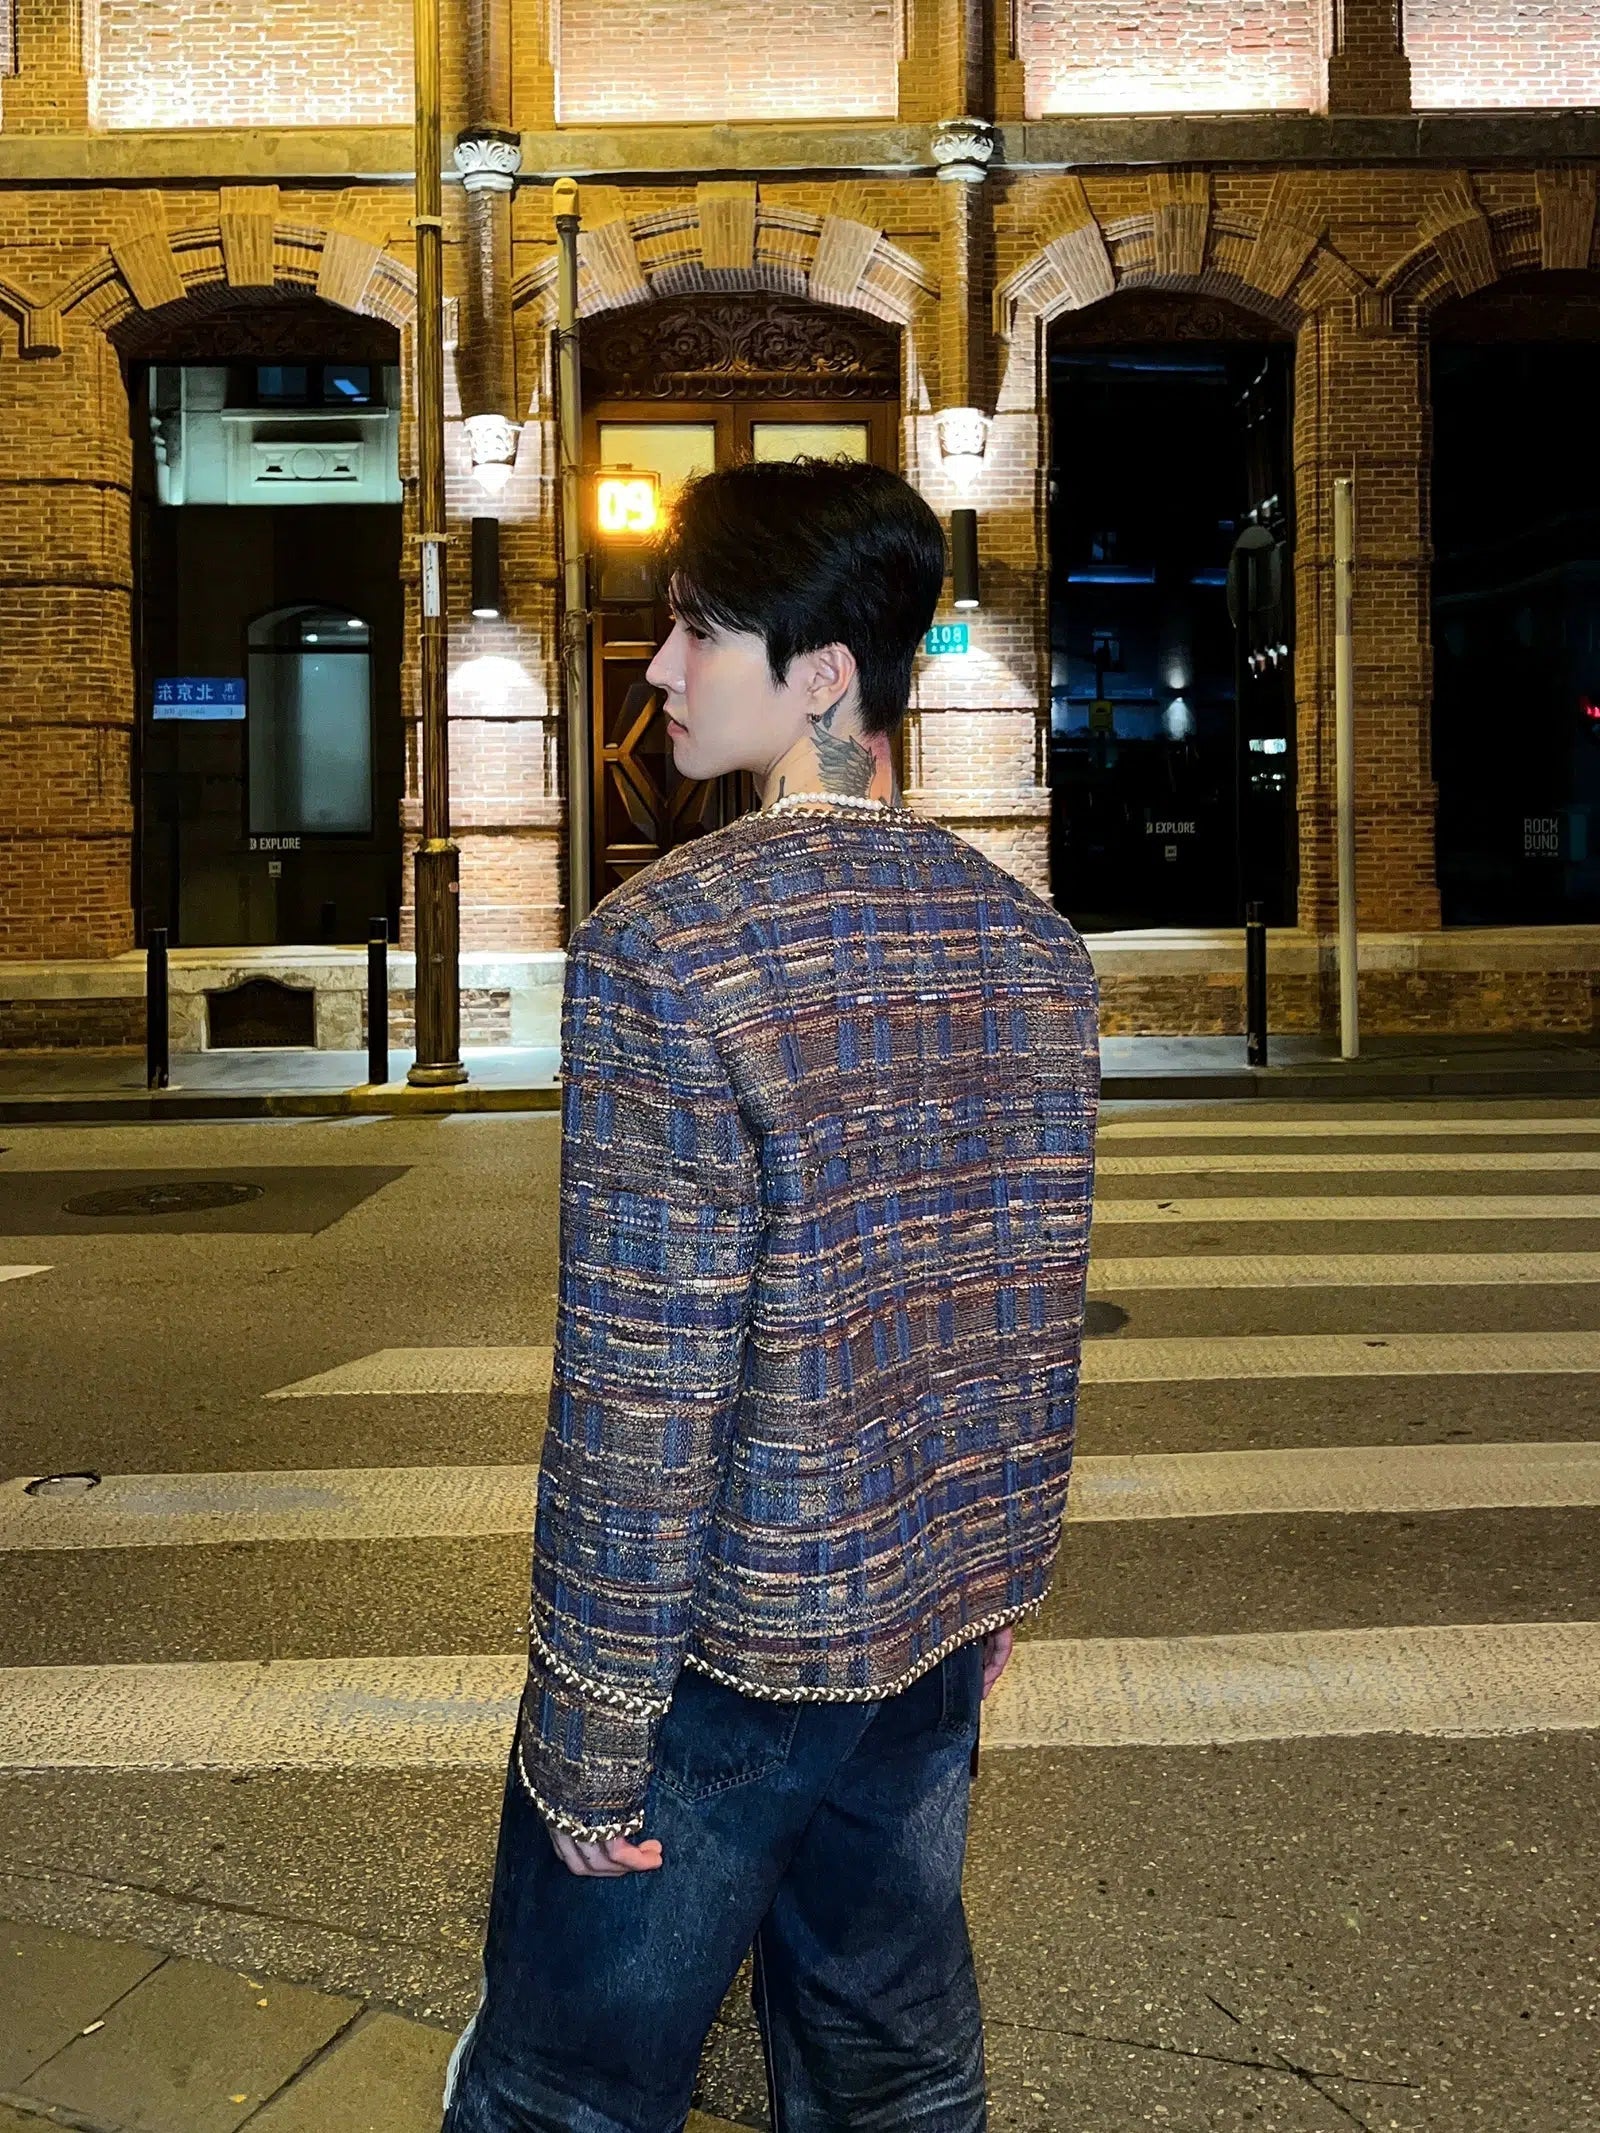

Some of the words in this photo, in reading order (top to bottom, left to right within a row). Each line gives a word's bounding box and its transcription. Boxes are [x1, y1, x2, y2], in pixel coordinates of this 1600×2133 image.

[931, 626, 962, 643] 108
[1156, 821, 1196, 834] EXPLORE
[1524, 818, 1558, 833] ROCK
[260, 837, 301, 850] EXPLORE
[1524, 834, 1559, 850] BUND
